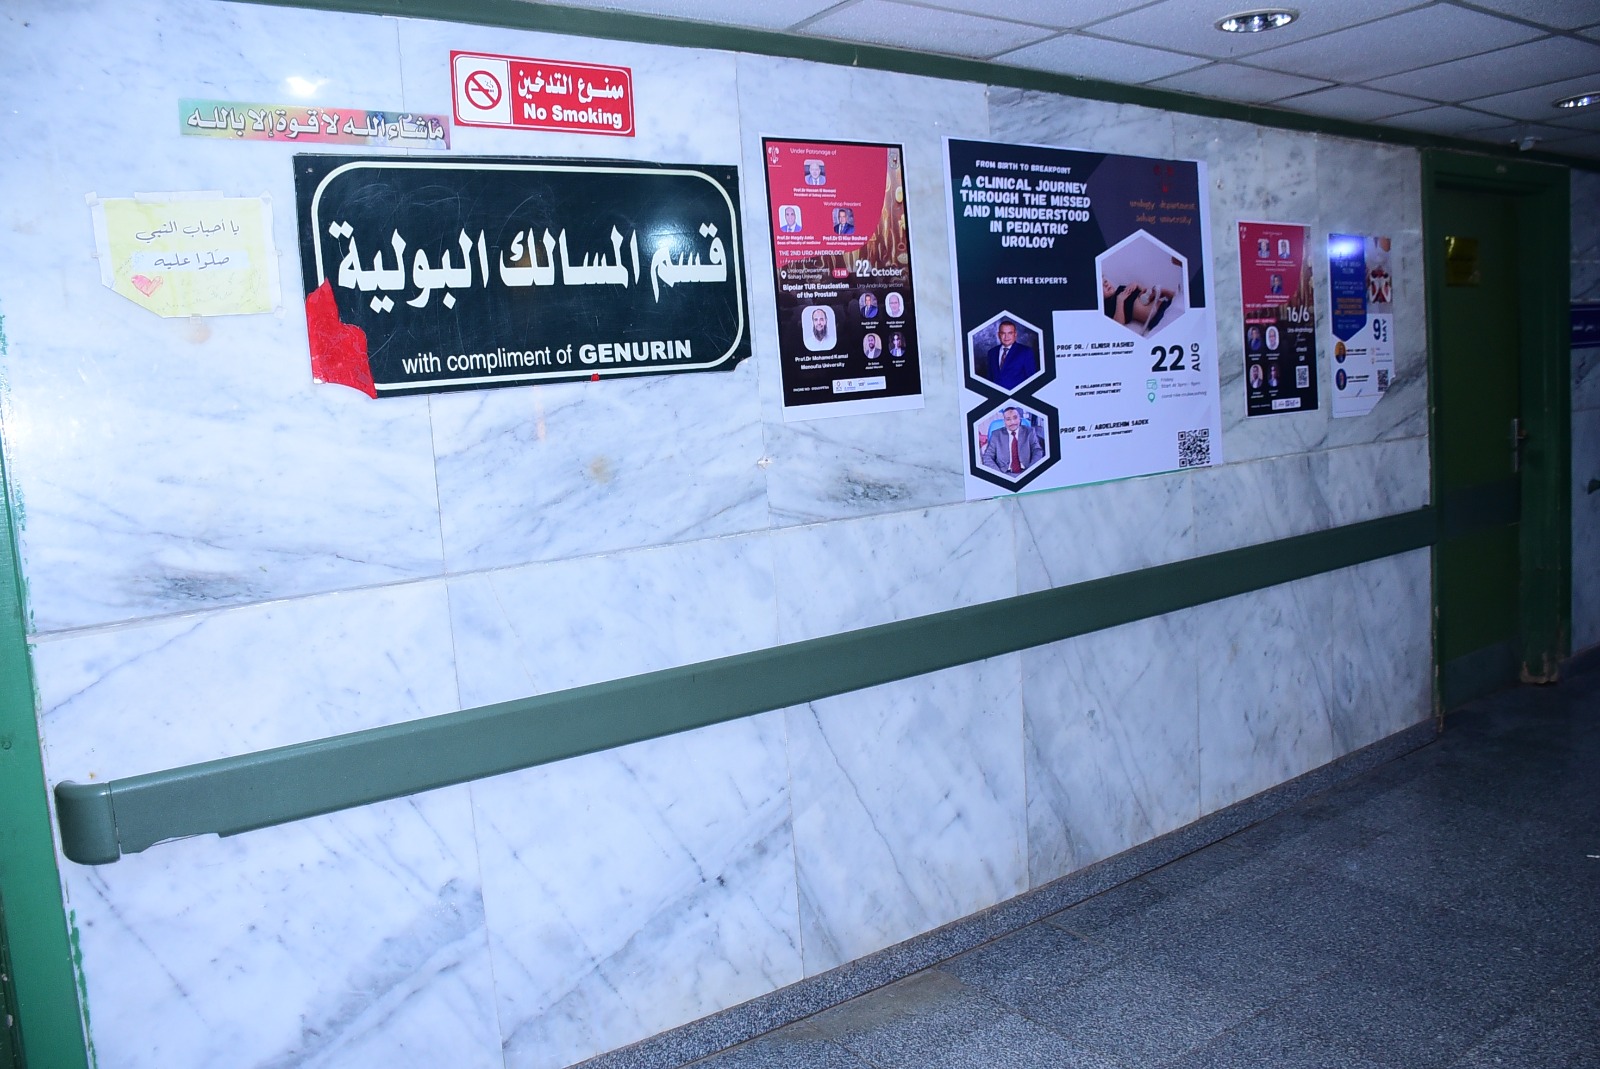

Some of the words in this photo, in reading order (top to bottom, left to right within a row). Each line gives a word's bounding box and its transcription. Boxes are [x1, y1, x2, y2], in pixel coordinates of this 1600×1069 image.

[518, 70, 572, 100] التدخين
[578, 77, 624, 103] ممنوع
[187, 106, 246, 136] بالله
[275, 109, 320, 139] قوة
[524, 103, 547, 120] No
[552, 105, 622, 129] Smoking
[976, 160, 995, 169] FROM
[997, 161, 1018, 170] BIRTH
[1030, 164, 1071, 174] BREAKPOINT
[962, 175, 972, 187] A
[976, 176, 1032, 191] CLINICAL
[1036, 179, 1088, 194] JOURNEY
[960, 189, 1019, 205] THROUGH
[1023, 192, 1047, 206] THE
[1050, 194, 1090, 208] MISSED
[963, 205, 990, 218] AND
[994, 206, 1090, 222] MISUNDERSTOOD
[135, 220, 178, 244] النبي
[990, 220, 1002, 232] IN
[1006, 221, 1069, 235] PEDIATRIC
[1001, 236, 1055, 249] UROLOGY
[154, 252, 191, 270] عليه
[328, 220, 490, 313] البولية
[499, 224, 641, 288] المسالك
[650, 221, 728, 304] قسم
[856, 260, 870, 278] 22
[872, 268, 902, 276] October
[996, 276, 1018, 284] MEET
[1287, 304, 1310, 323] 16/6
[1373, 318, 1381, 340] 9
[402, 351, 442, 376] with
[446, 346, 552, 380] compliment
[555, 342, 574, 366] of
[578, 339, 692, 364] GENURIN
[1151, 345, 1185, 372] 22
[1191, 343, 1201, 372] AUG
